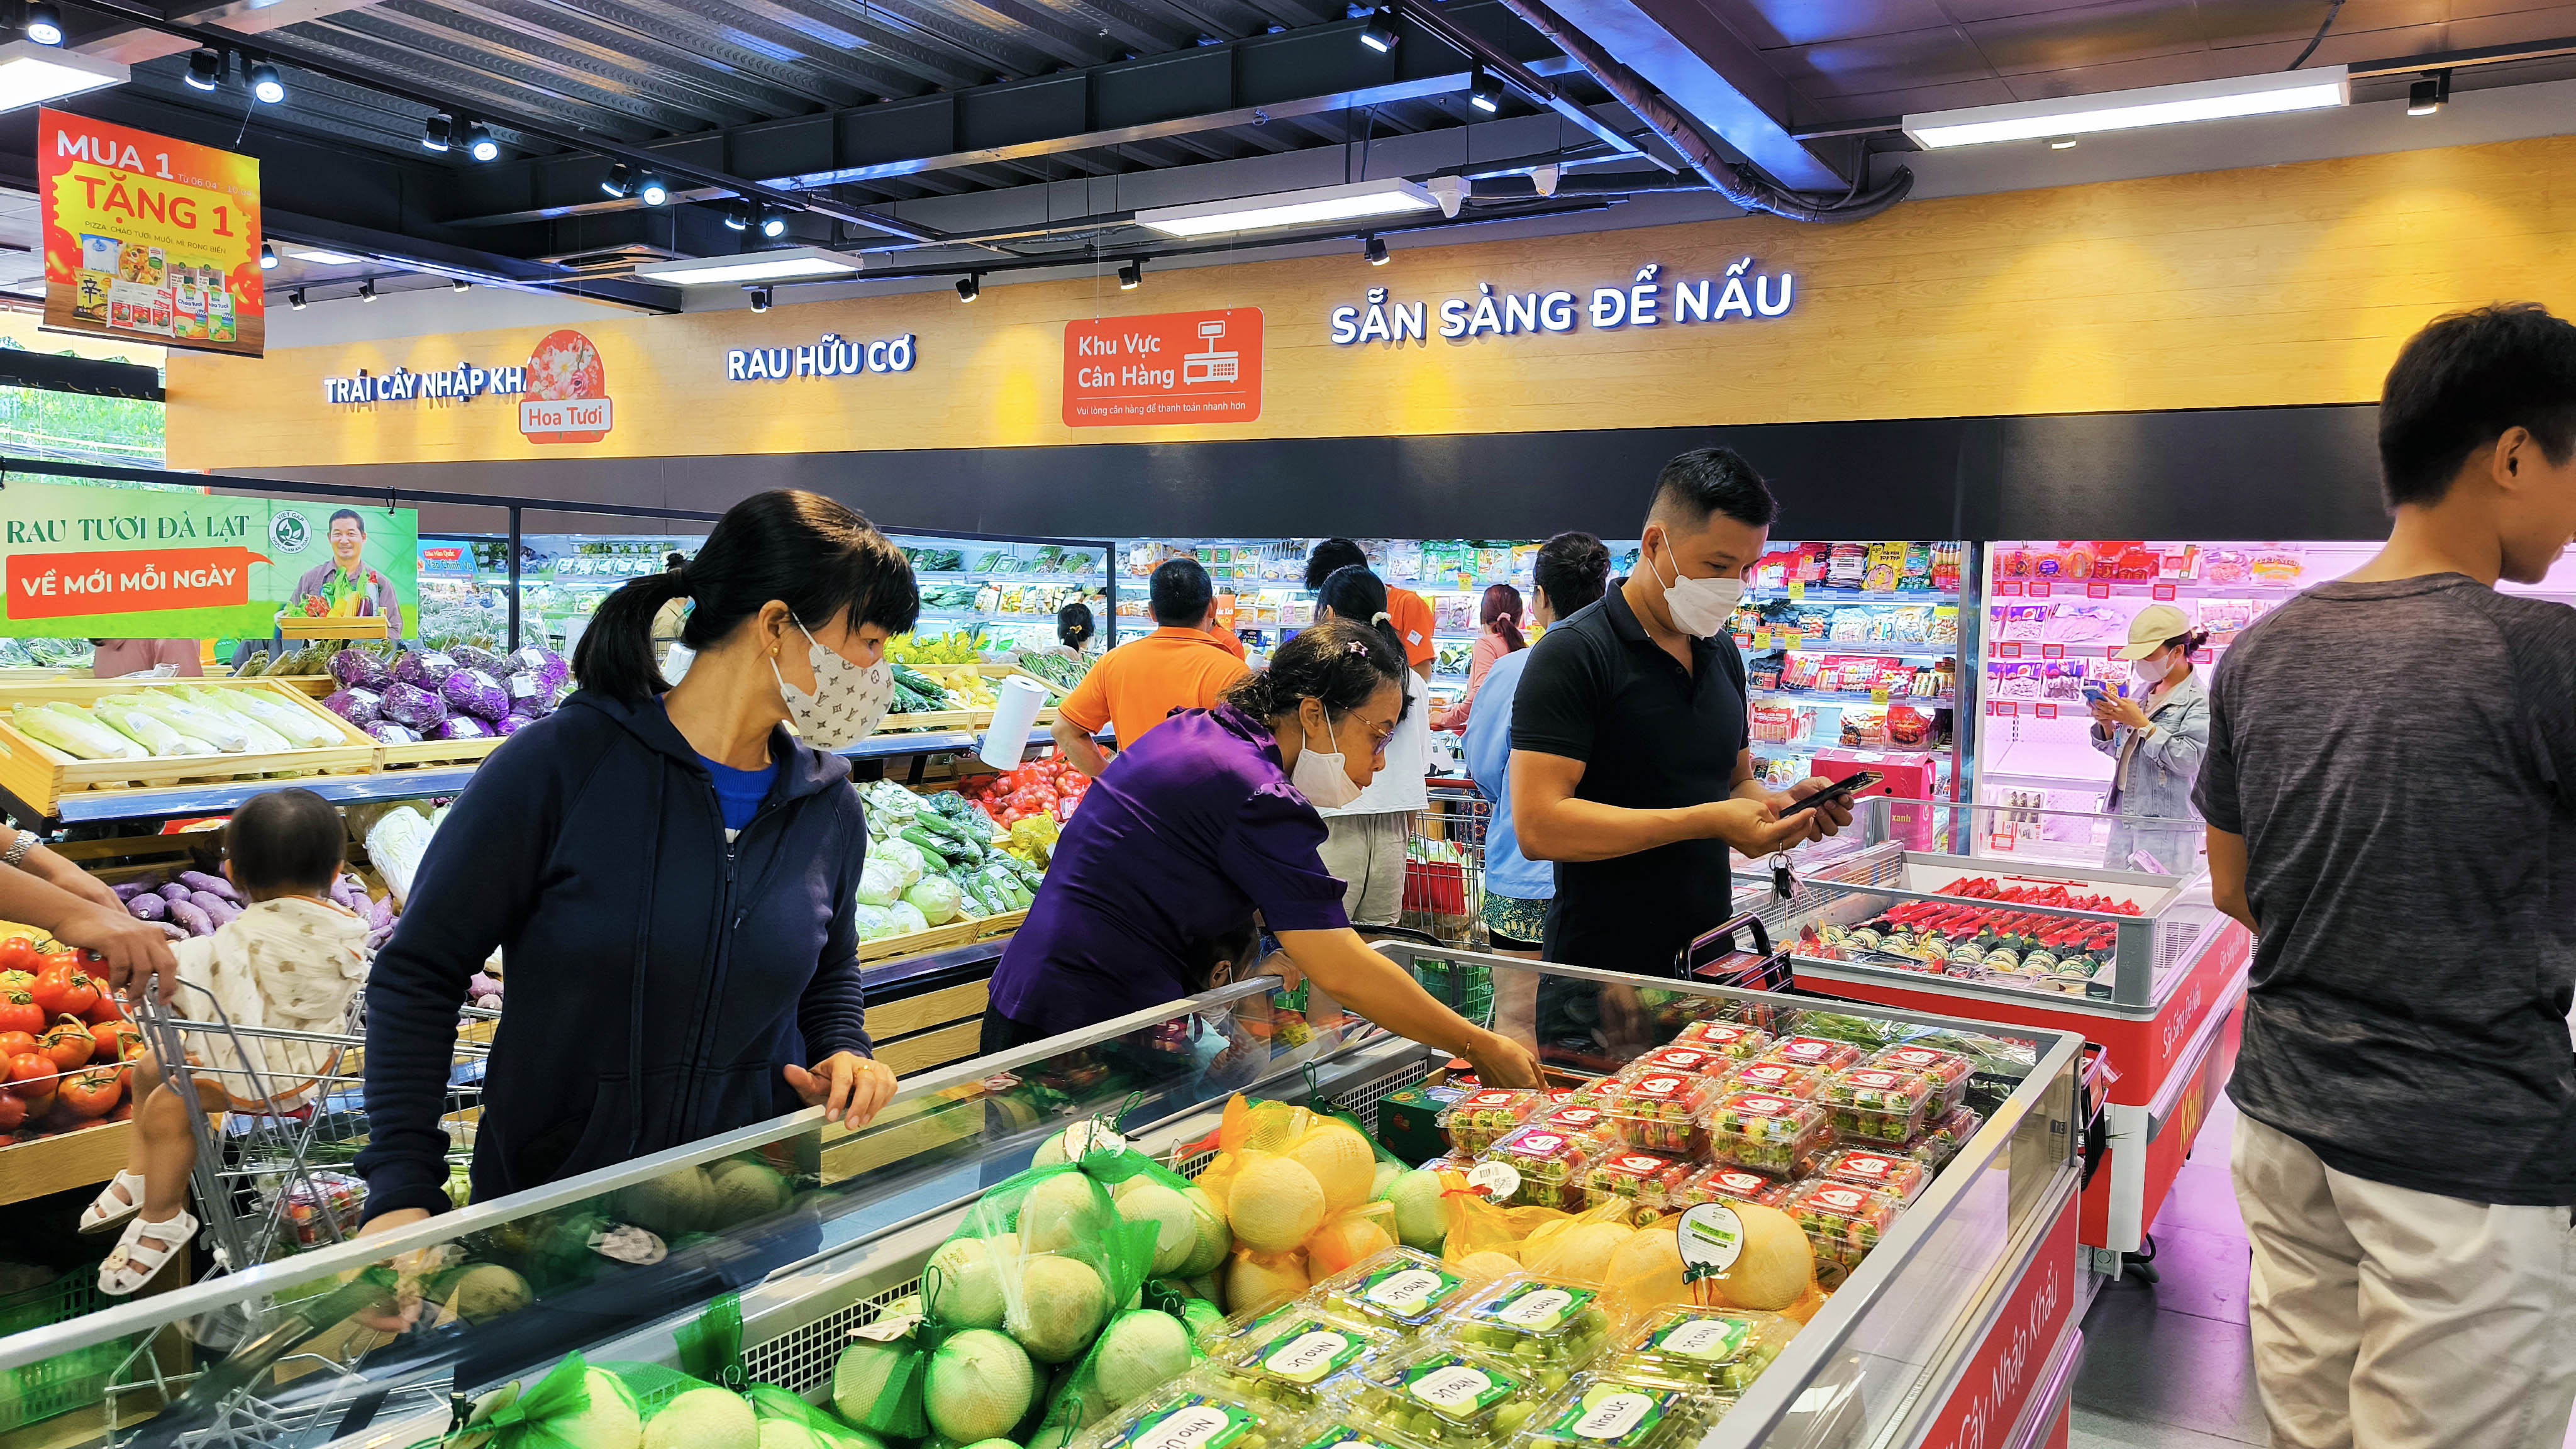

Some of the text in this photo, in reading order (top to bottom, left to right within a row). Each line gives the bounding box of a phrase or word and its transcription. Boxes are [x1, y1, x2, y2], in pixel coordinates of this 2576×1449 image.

[58, 130, 174, 179] MUA 1
[74, 171, 233, 237] TẶNG 1
[1331, 256, 1792, 343] SẴN SÀNG ĐỂ NẤU
[728, 333, 911, 380] RAU HỮU CƠ
[1079, 333, 1160, 358] Khu Vực
[324, 369, 372, 402] TRÁI
[377, 366, 416, 400] CÂY
[421, 361, 484, 402] NHẬP
[1078, 363, 1175, 389] Cân Hàng
[529, 405, 602, 426] Hoa Tươi
[1077, 401, 1246, 416] Vui lòng cân hàng để thanh toán nhanh hơn
[7, 511, 249, 543] RAU TƯƠI ĐÀ LẠT
[292, 513, 304, 521] GAP
[21, 563, 236, 597] VỀ MỚI MỖI NGÀY
[1892, 814, 1911, 823] xanh
[1403, 1279, 1431, 1292] Nho
[1533, 1297, 1560, 1309] Nho
[1694, 1327, 1719, 1339] Nho
[1991, 1324, 2026, 1423] Nhập
[2029, 1260, 2058, 1350] Khẩu
[1288, 1341, 1336, 1368] Nho Úc
[1449, 1377, 1479, 1391] Nho
[1179, 1418, 1215, 1438] Nho
[1586, 1413, 1616, 1430] Nho
